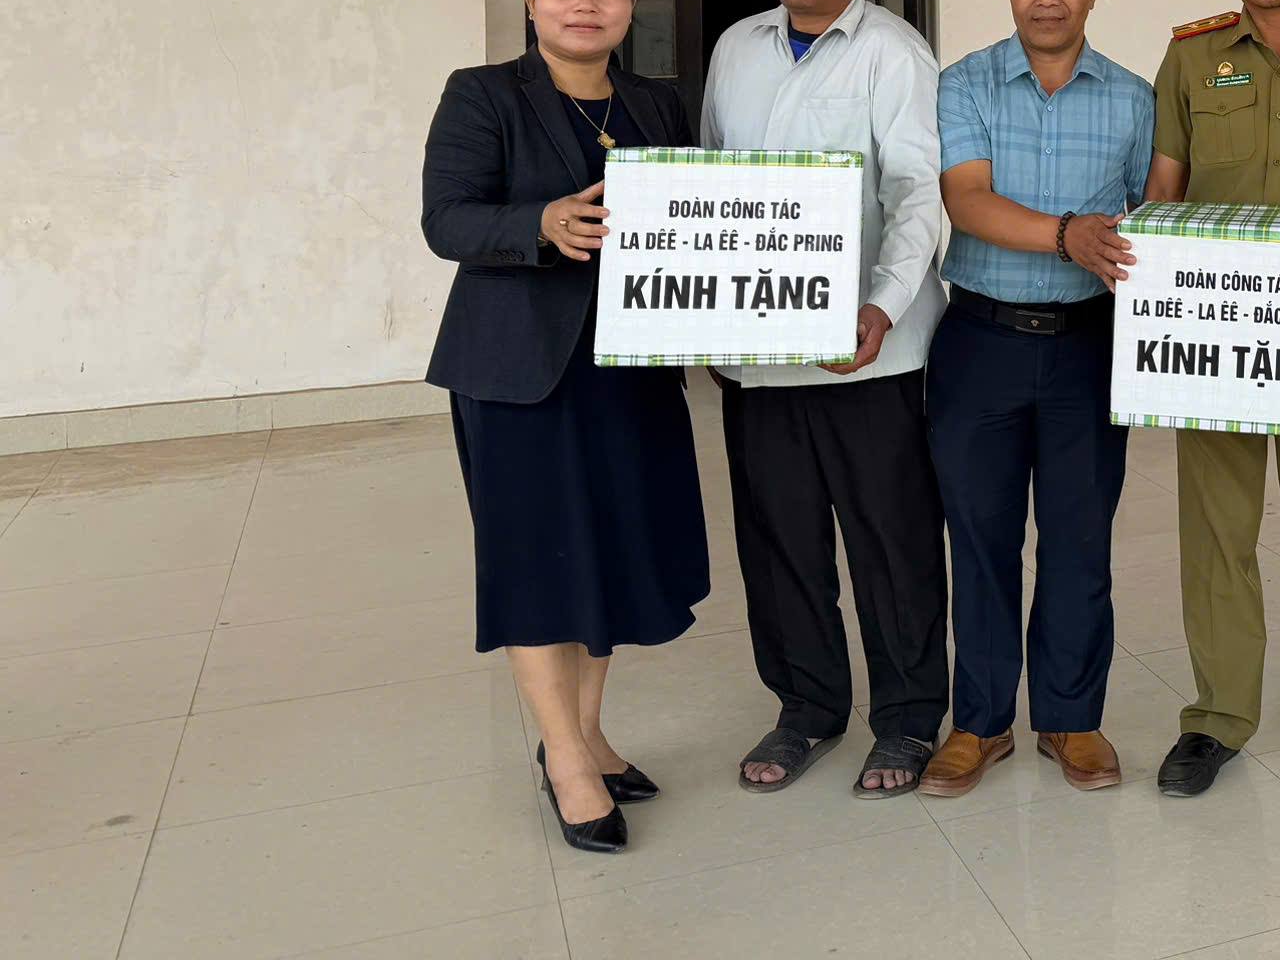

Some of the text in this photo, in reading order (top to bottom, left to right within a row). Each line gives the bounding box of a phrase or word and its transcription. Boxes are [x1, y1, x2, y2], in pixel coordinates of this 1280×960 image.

[668, 196, 801, 220] ĐOÀN CÔNG TÁC
[619, 231, 640, 250] LA
[645, 228, 677, 251] DÊÊ
[693, 232, 714, 251] LA
[718, 229, 739, 251] ÊÊ
[755, 226, 789, 252] ĐẮC
[793, 233, 844, 253] PRING
[622, 267, 830, 318] KÍNH TẶNG
[1175, 268, 1217, 290] ĐOÀN
[1221, 270, 1263, 293] CÔNG
[1132, 298, 1151, 317] LA
[1154, 297, 1183, 319] DÊÊ
[1198, 302, 1216, 321] LA
[1220, 300, 1239, 322] ÊÊ
[1136, 333, 1220, 378] KÍNH
